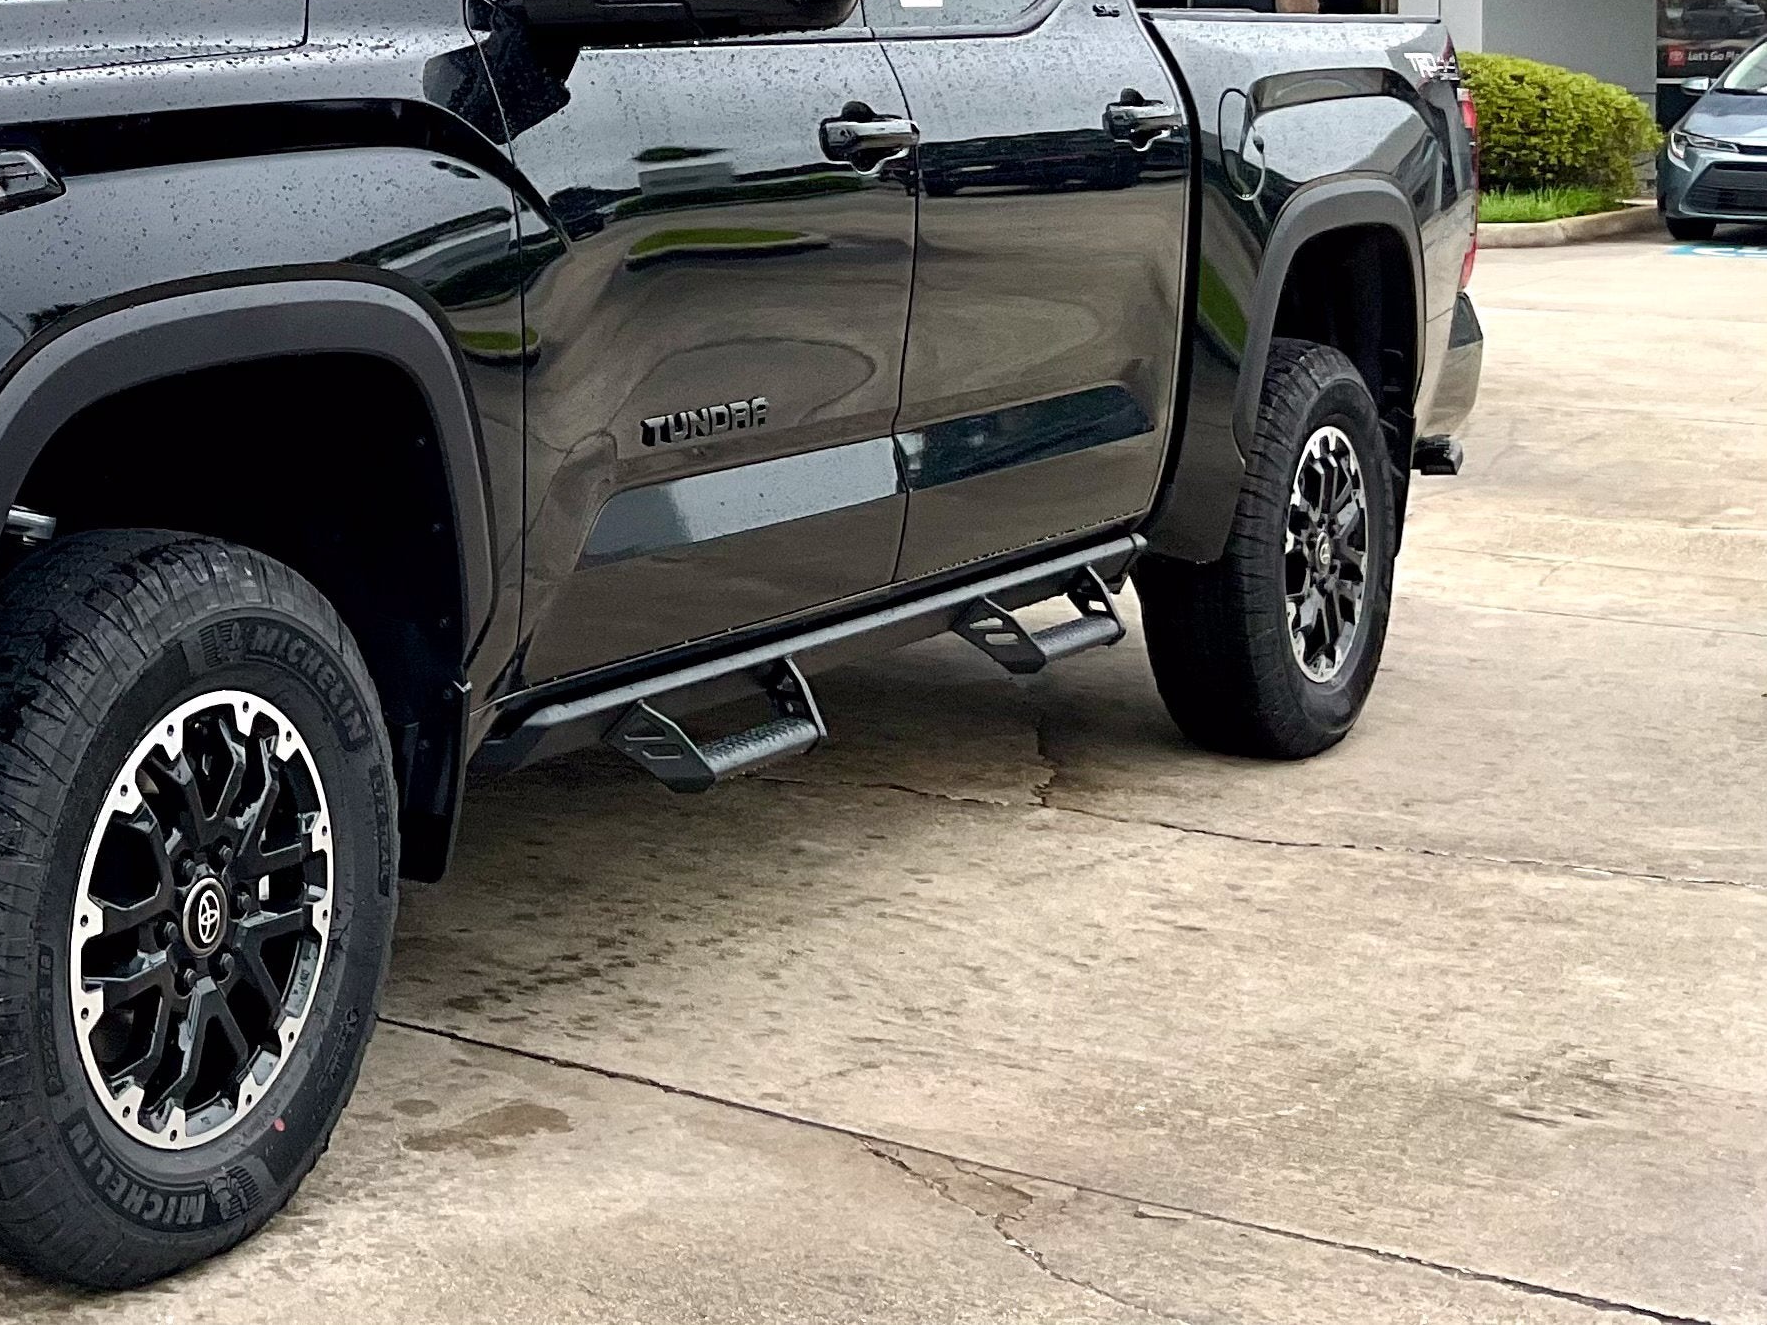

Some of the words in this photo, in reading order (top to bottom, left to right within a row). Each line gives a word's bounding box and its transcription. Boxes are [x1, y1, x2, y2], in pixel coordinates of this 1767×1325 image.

[1404, 52, 1437, 78] TRD
[640, 395, 769, 447] TUNDRA
[249, 624, 368, 743] MICHELIN
[67, 1123, 207, 1226] MICHELIN
